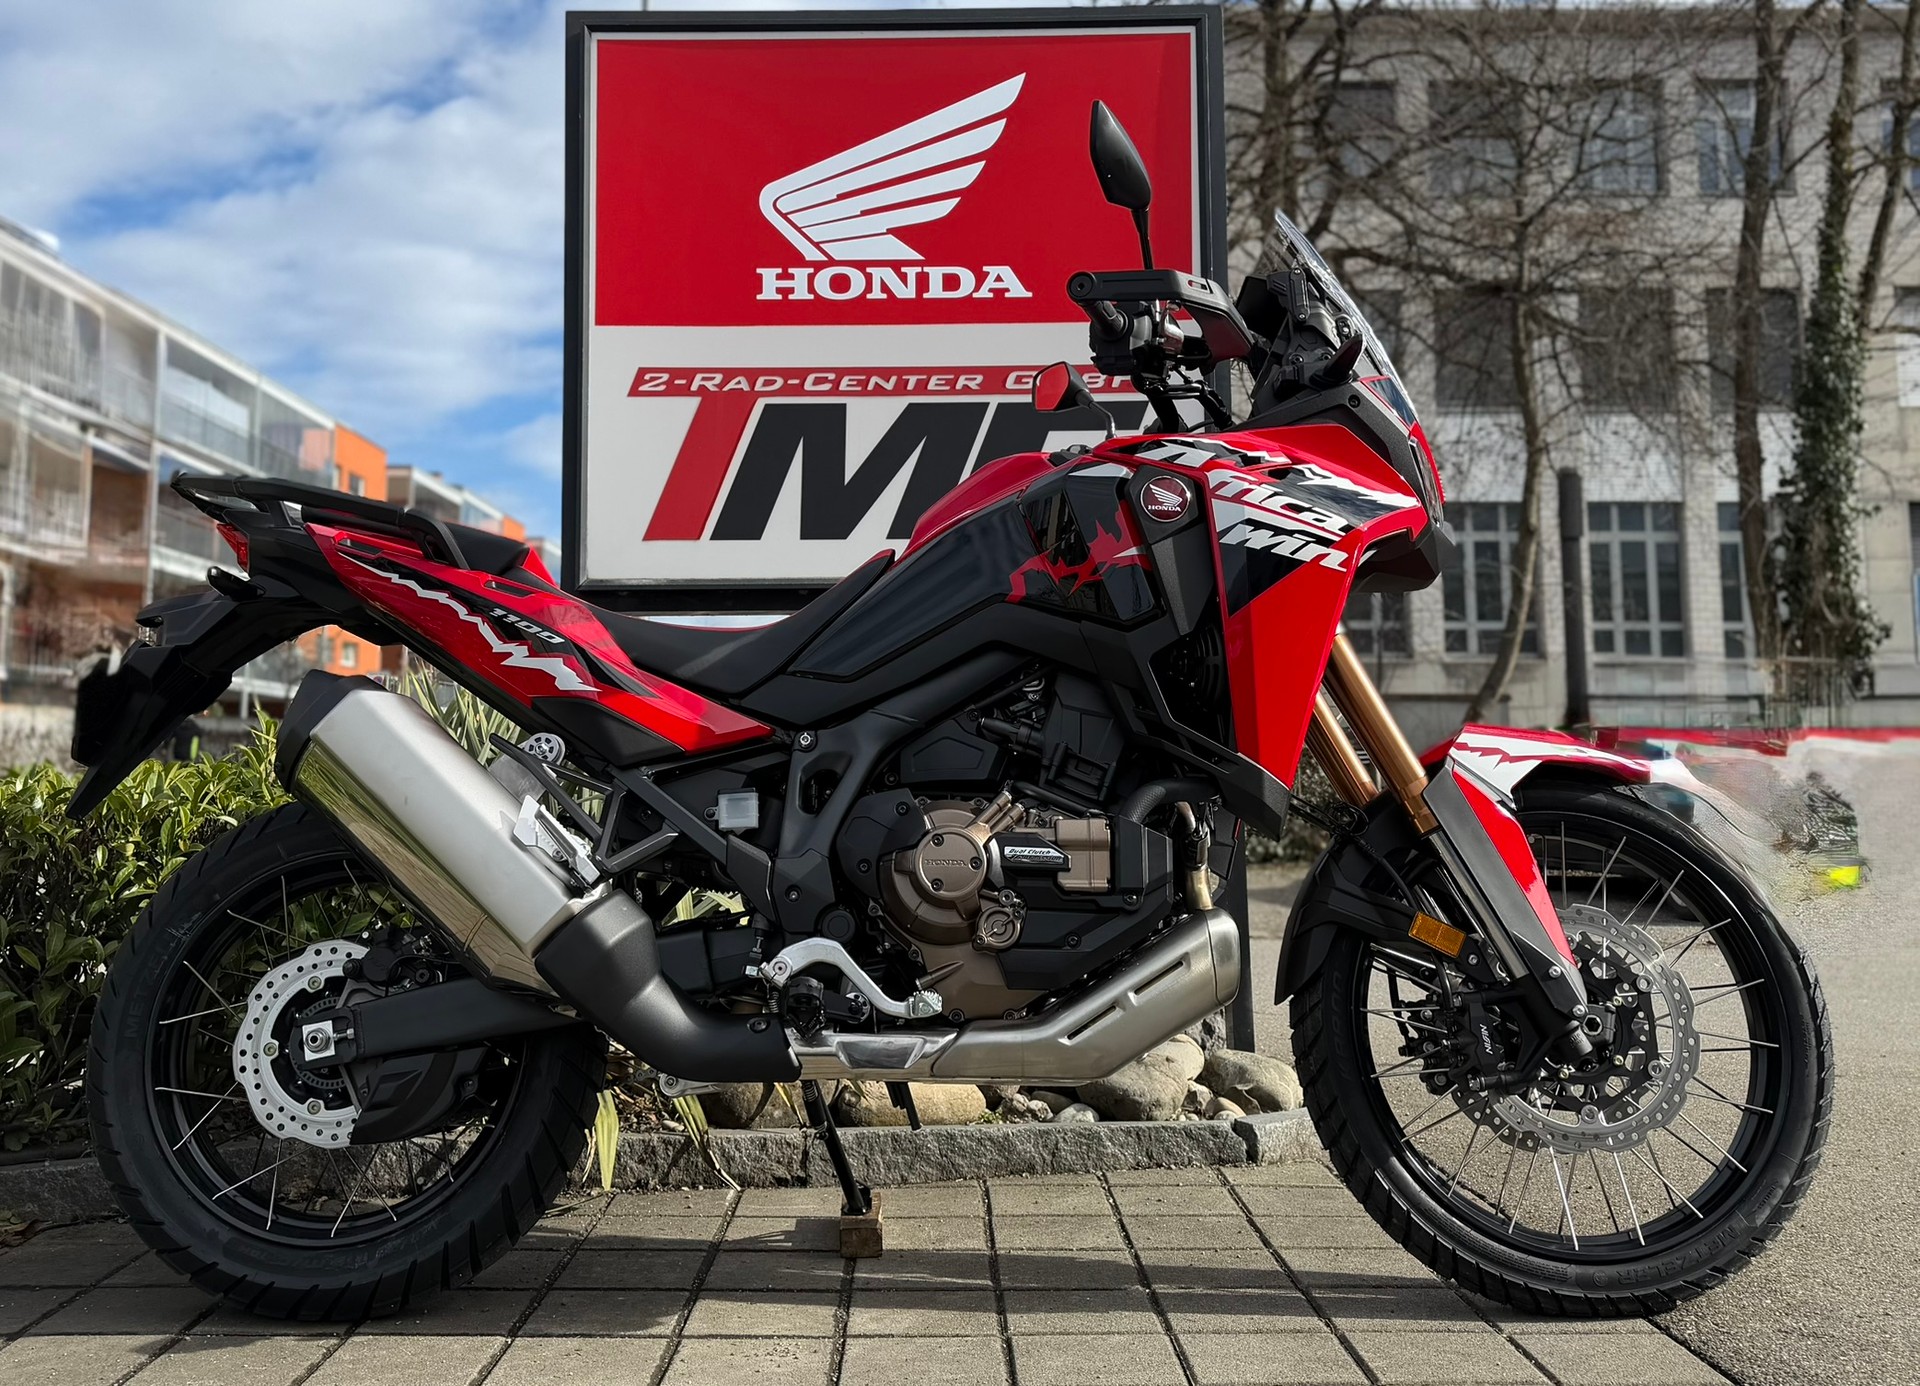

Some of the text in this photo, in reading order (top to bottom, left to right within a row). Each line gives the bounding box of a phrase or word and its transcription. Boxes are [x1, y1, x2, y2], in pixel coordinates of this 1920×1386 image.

[756, 266, 1033, 300] HONDA
[1005, 370, 1132, 390] GB
[1147, 503, 1182, 513] HONDA
[488, 607, 566, 644] 1100
[924, 859, 968, 867] HONDA
[1614, 1225, 1740, 1287] METZELER
